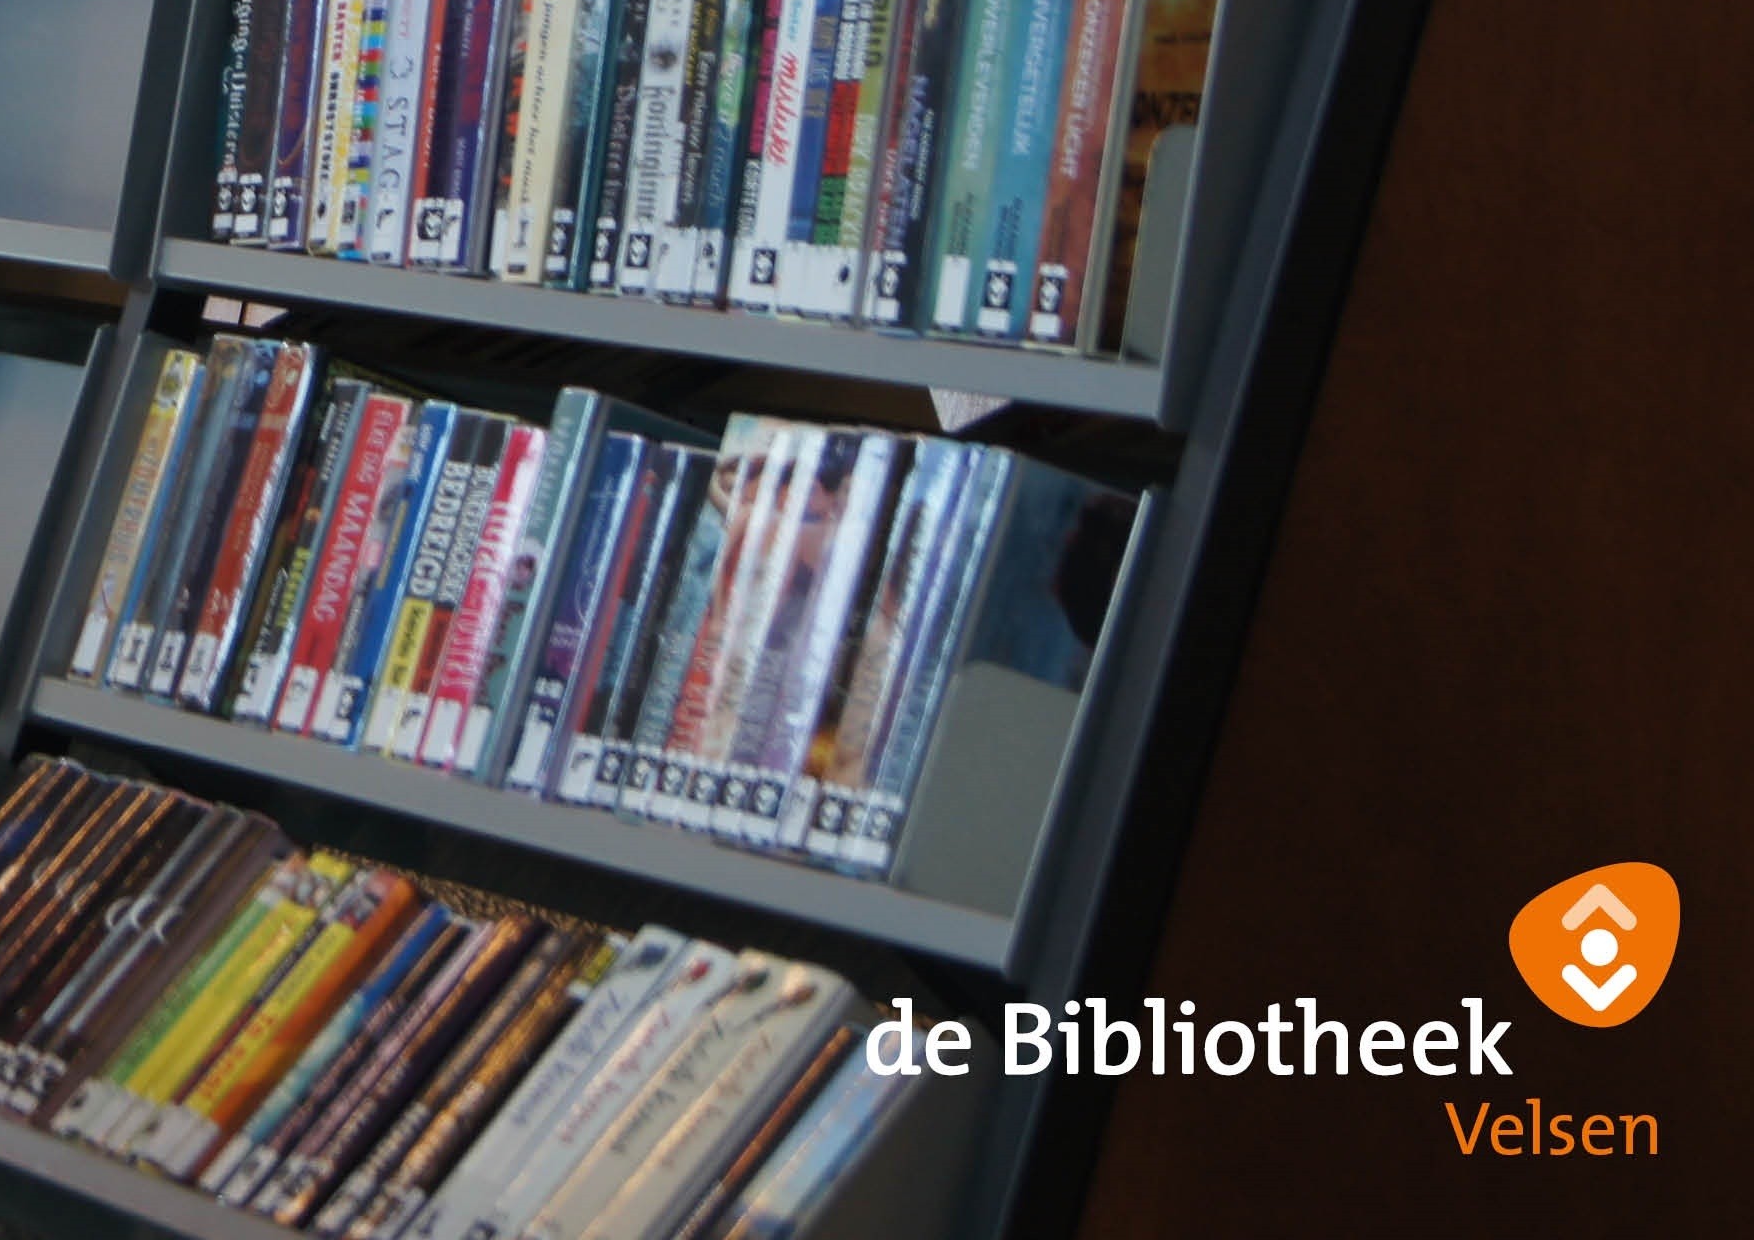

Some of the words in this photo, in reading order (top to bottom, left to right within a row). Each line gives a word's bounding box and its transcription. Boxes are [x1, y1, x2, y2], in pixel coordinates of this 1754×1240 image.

[329, 1, 348, 62] BARTER
[1059, 112, 1083, 180] LICHT
[310, 489, 371, 625] MAANDAG
